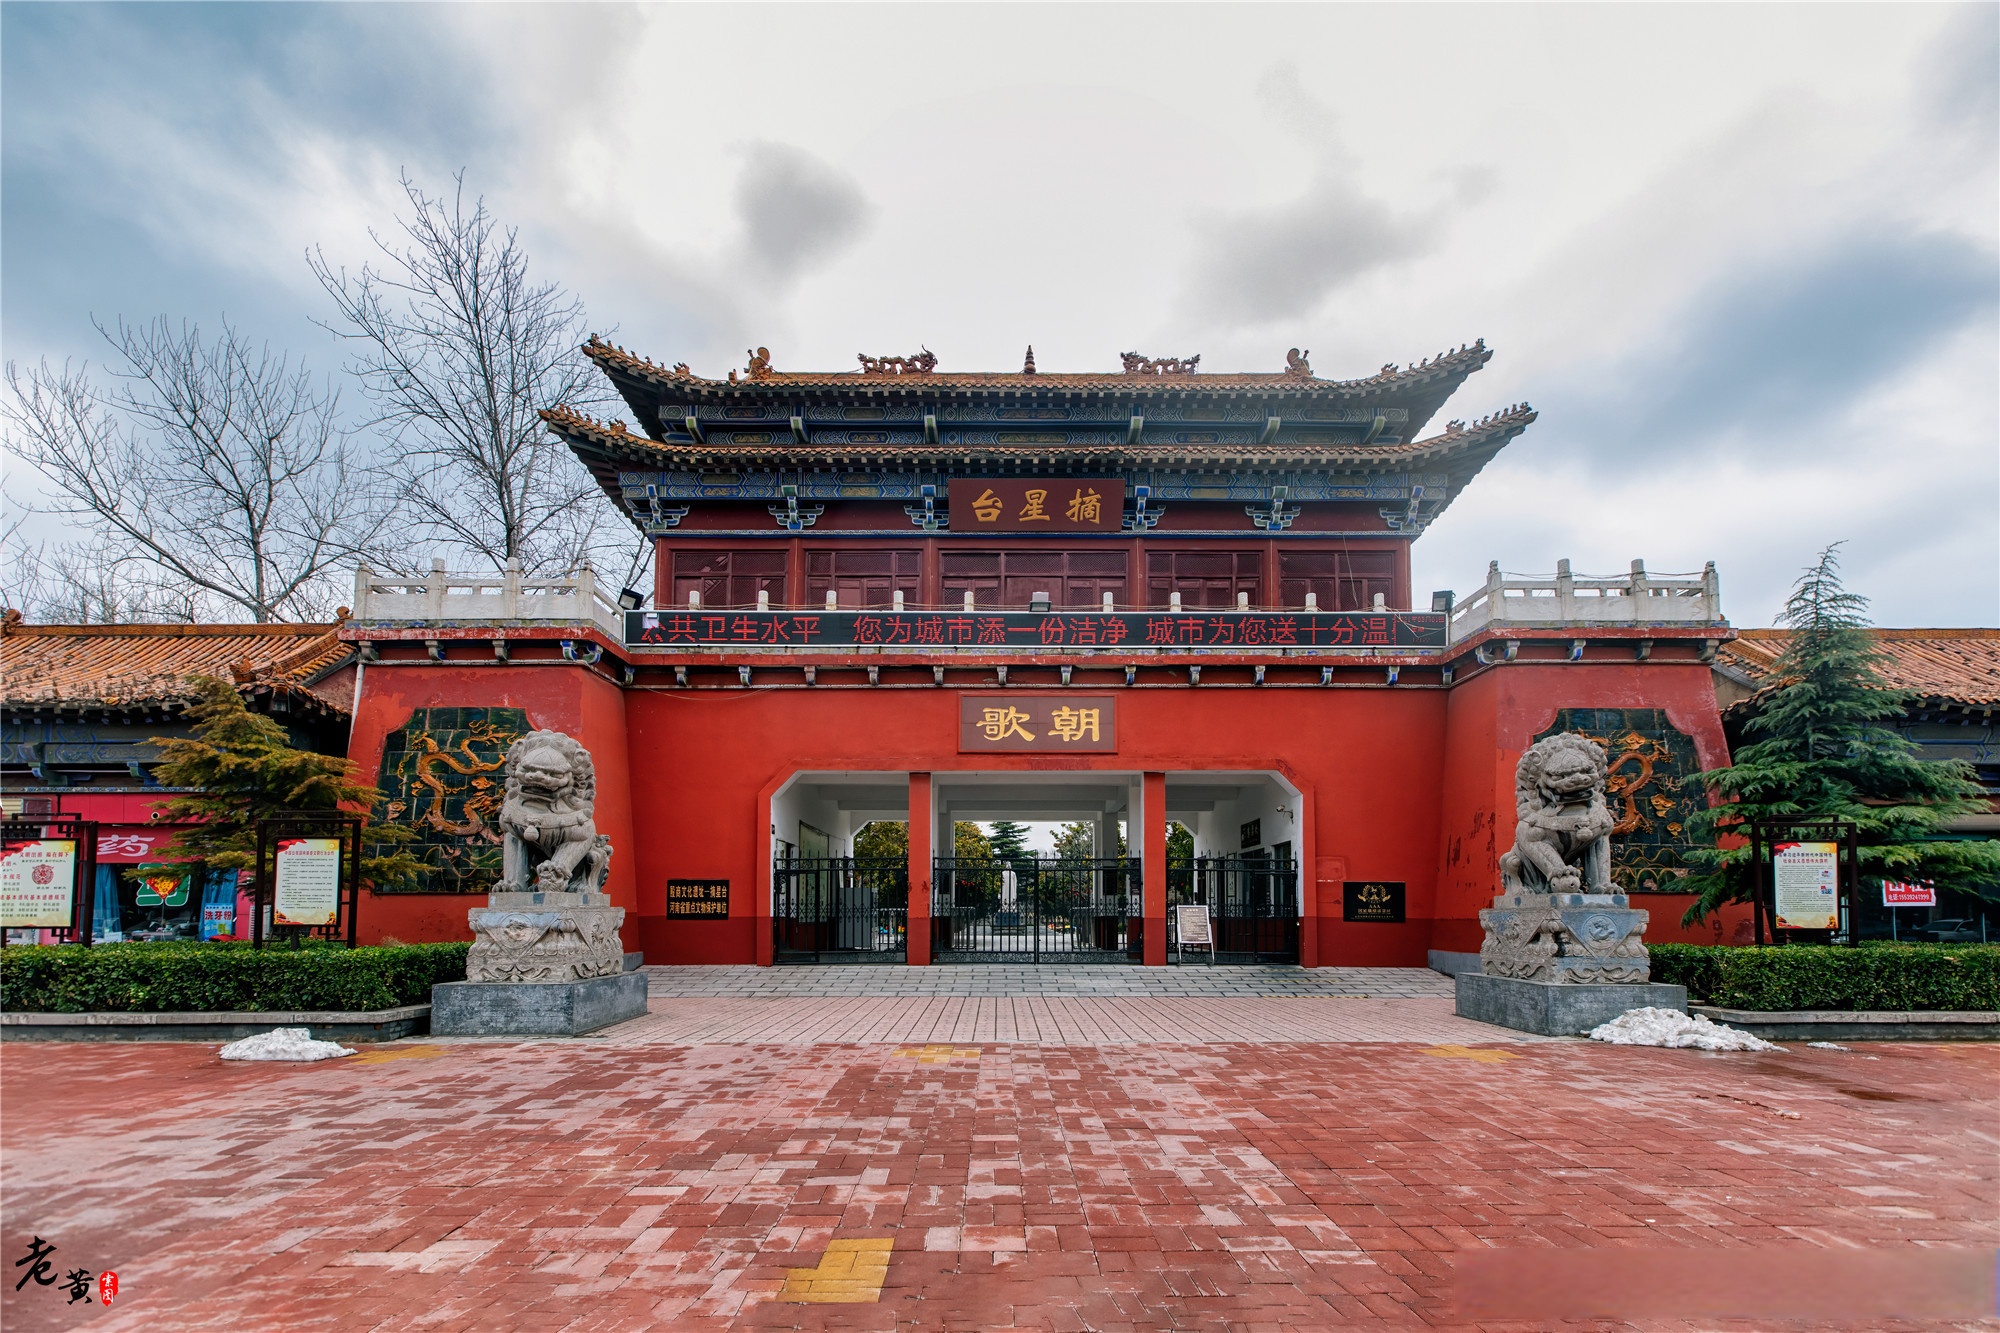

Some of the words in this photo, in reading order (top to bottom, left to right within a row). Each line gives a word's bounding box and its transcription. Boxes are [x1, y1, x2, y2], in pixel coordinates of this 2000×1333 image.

[853, 615, 1128, 645] 您为城市添一份洁净
[1145, 615, 1396, 645] 城市为您送十分温
